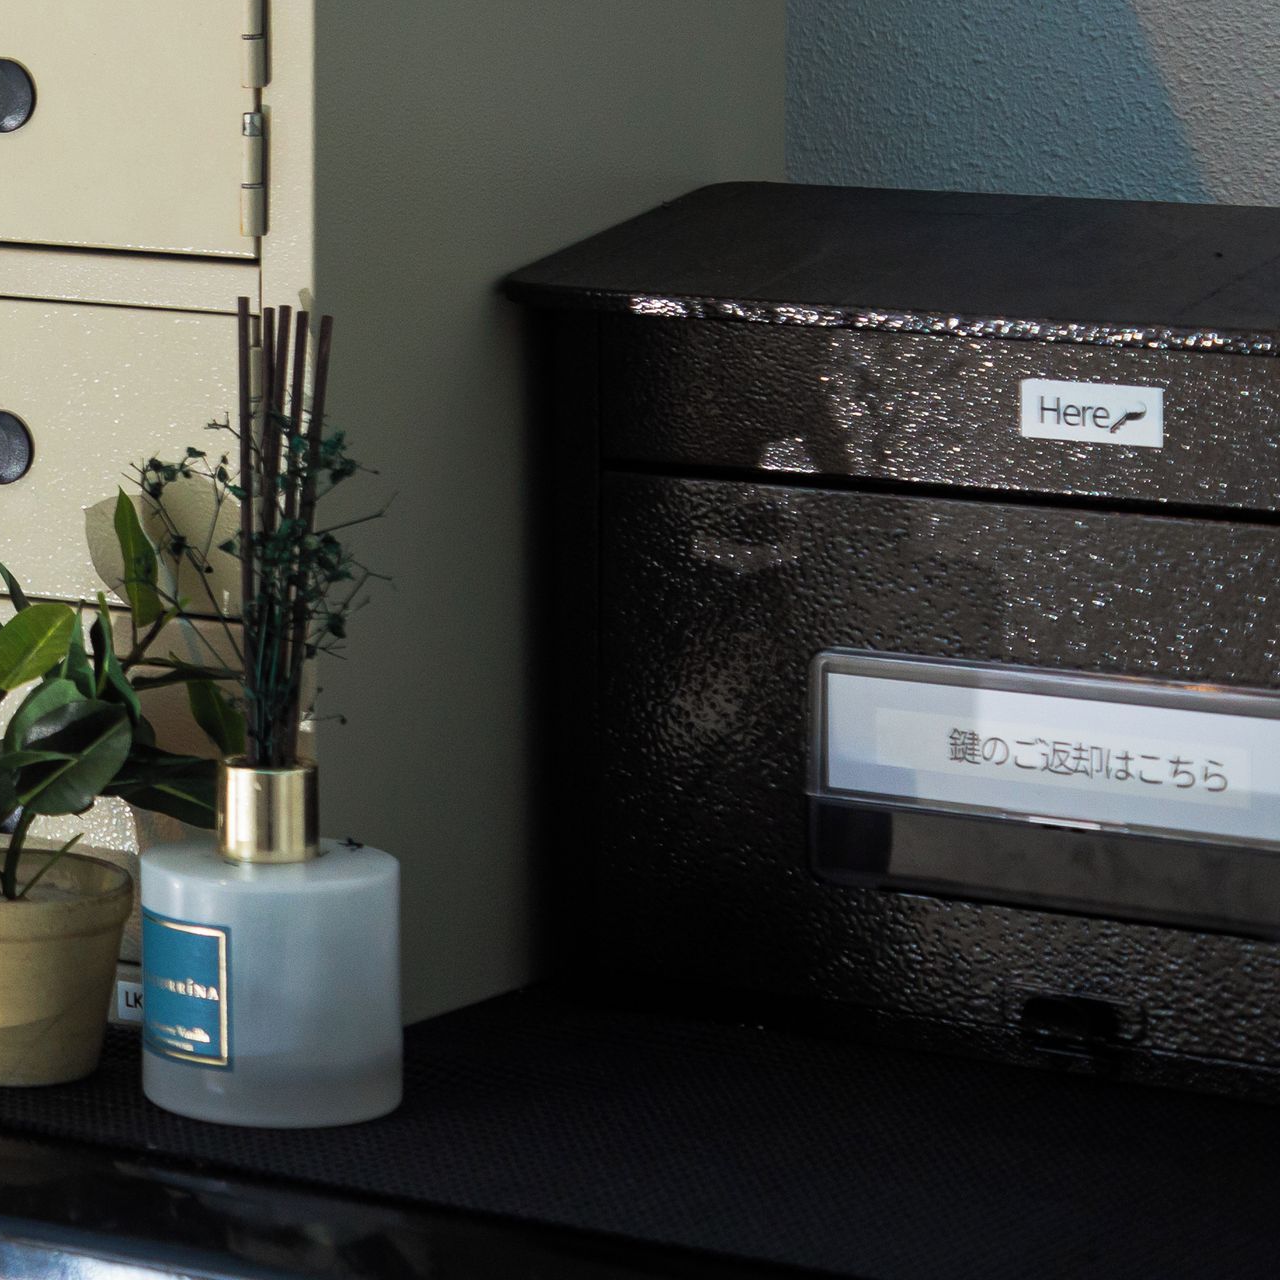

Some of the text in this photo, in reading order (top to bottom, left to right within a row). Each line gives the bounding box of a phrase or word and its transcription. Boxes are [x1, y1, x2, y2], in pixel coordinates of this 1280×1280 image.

[1039, 395, 1111, 429] Here
[948, 727, 1229, 793] 鍵のご返却はこちら
[124, 990, 144, 1010] LK
